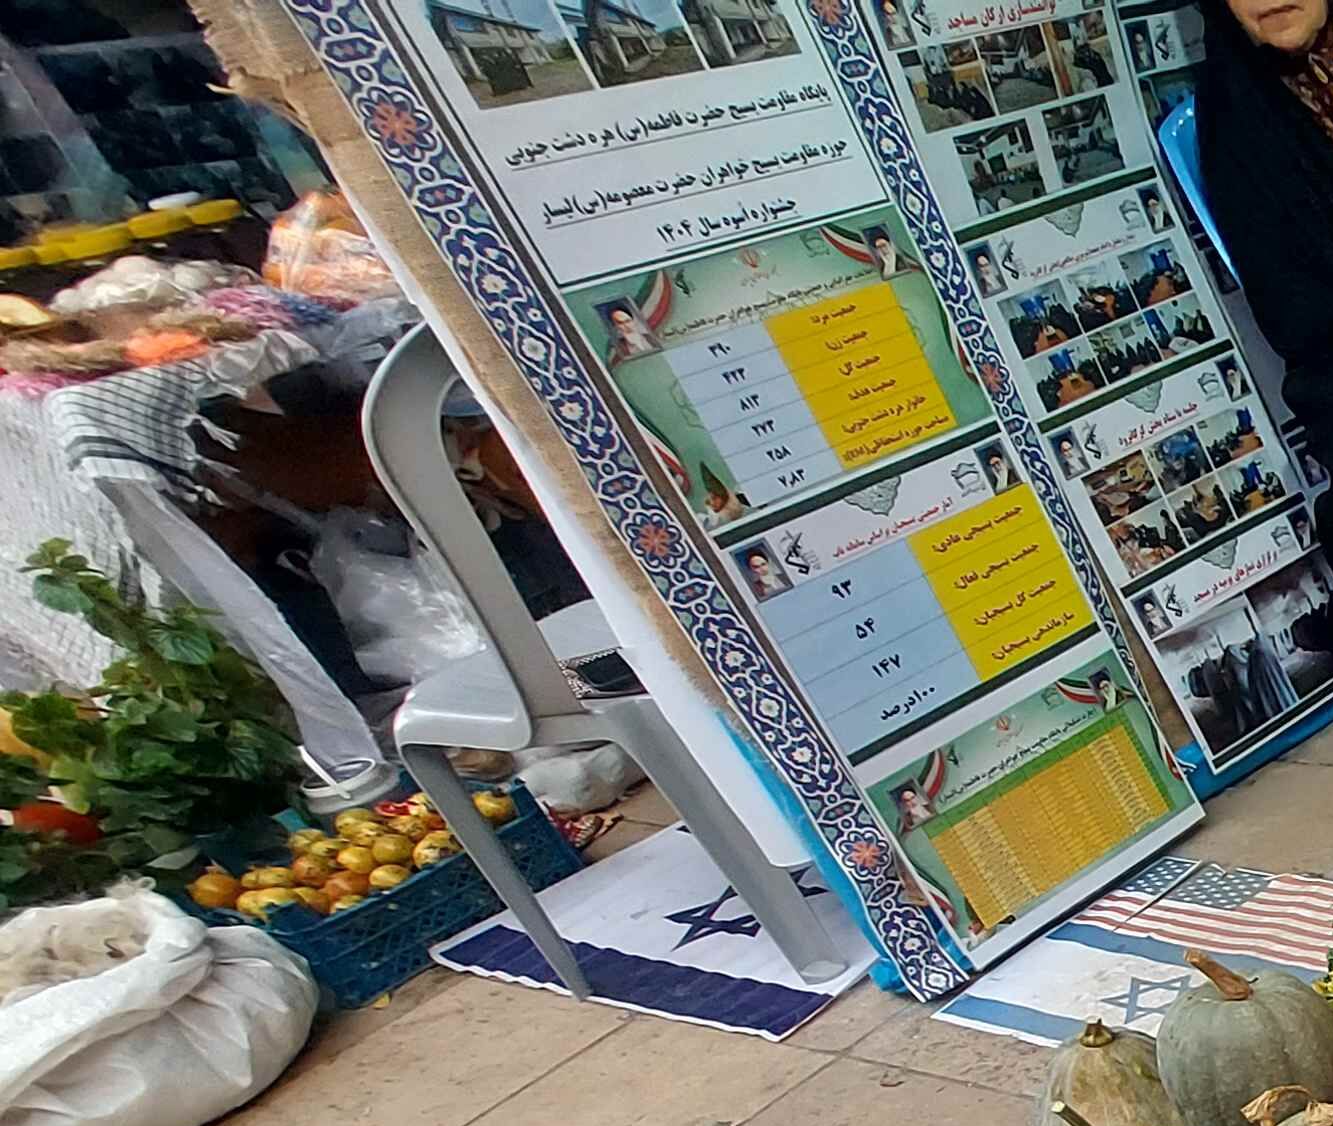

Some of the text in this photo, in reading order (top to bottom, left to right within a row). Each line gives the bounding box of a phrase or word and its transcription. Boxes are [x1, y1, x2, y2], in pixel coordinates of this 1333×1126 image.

[757, 90, 798, 111] مقاومت
[798, 83, 831, 102] پایگاه
[684, 105, 725, 127] حضرت
[727, 101, 757, 120] بسیج
[550, 132, 586, 151] دشت
[820, 140, 847, 158] حوزه
[504, 141, 550, 166] جنوبی
[782, 144, 820, 165] مقاومت
[700, 161, 749, 187] خواهران
[750, 155, 780, 174] بسیج
[654, 174, 696, 195] حضرت
[749, 198, 796, 223] جشنواره
[656, 218, 692, 243] ۱۴۰۴
[697, 216, 721, 237] سال
[740, 395, 759, 410] ۸۱۳
[993, 506, 1022, 524] جمعیت
[1010, 543, 1039, 562] جمعیت
[832, 580, 851, 598] ۹۳
[1028, 579, 1056, 598] جمعیت
[856, 618, 874, 639] ۵۴
[872, 654, 900, 677] ۱۴۷
